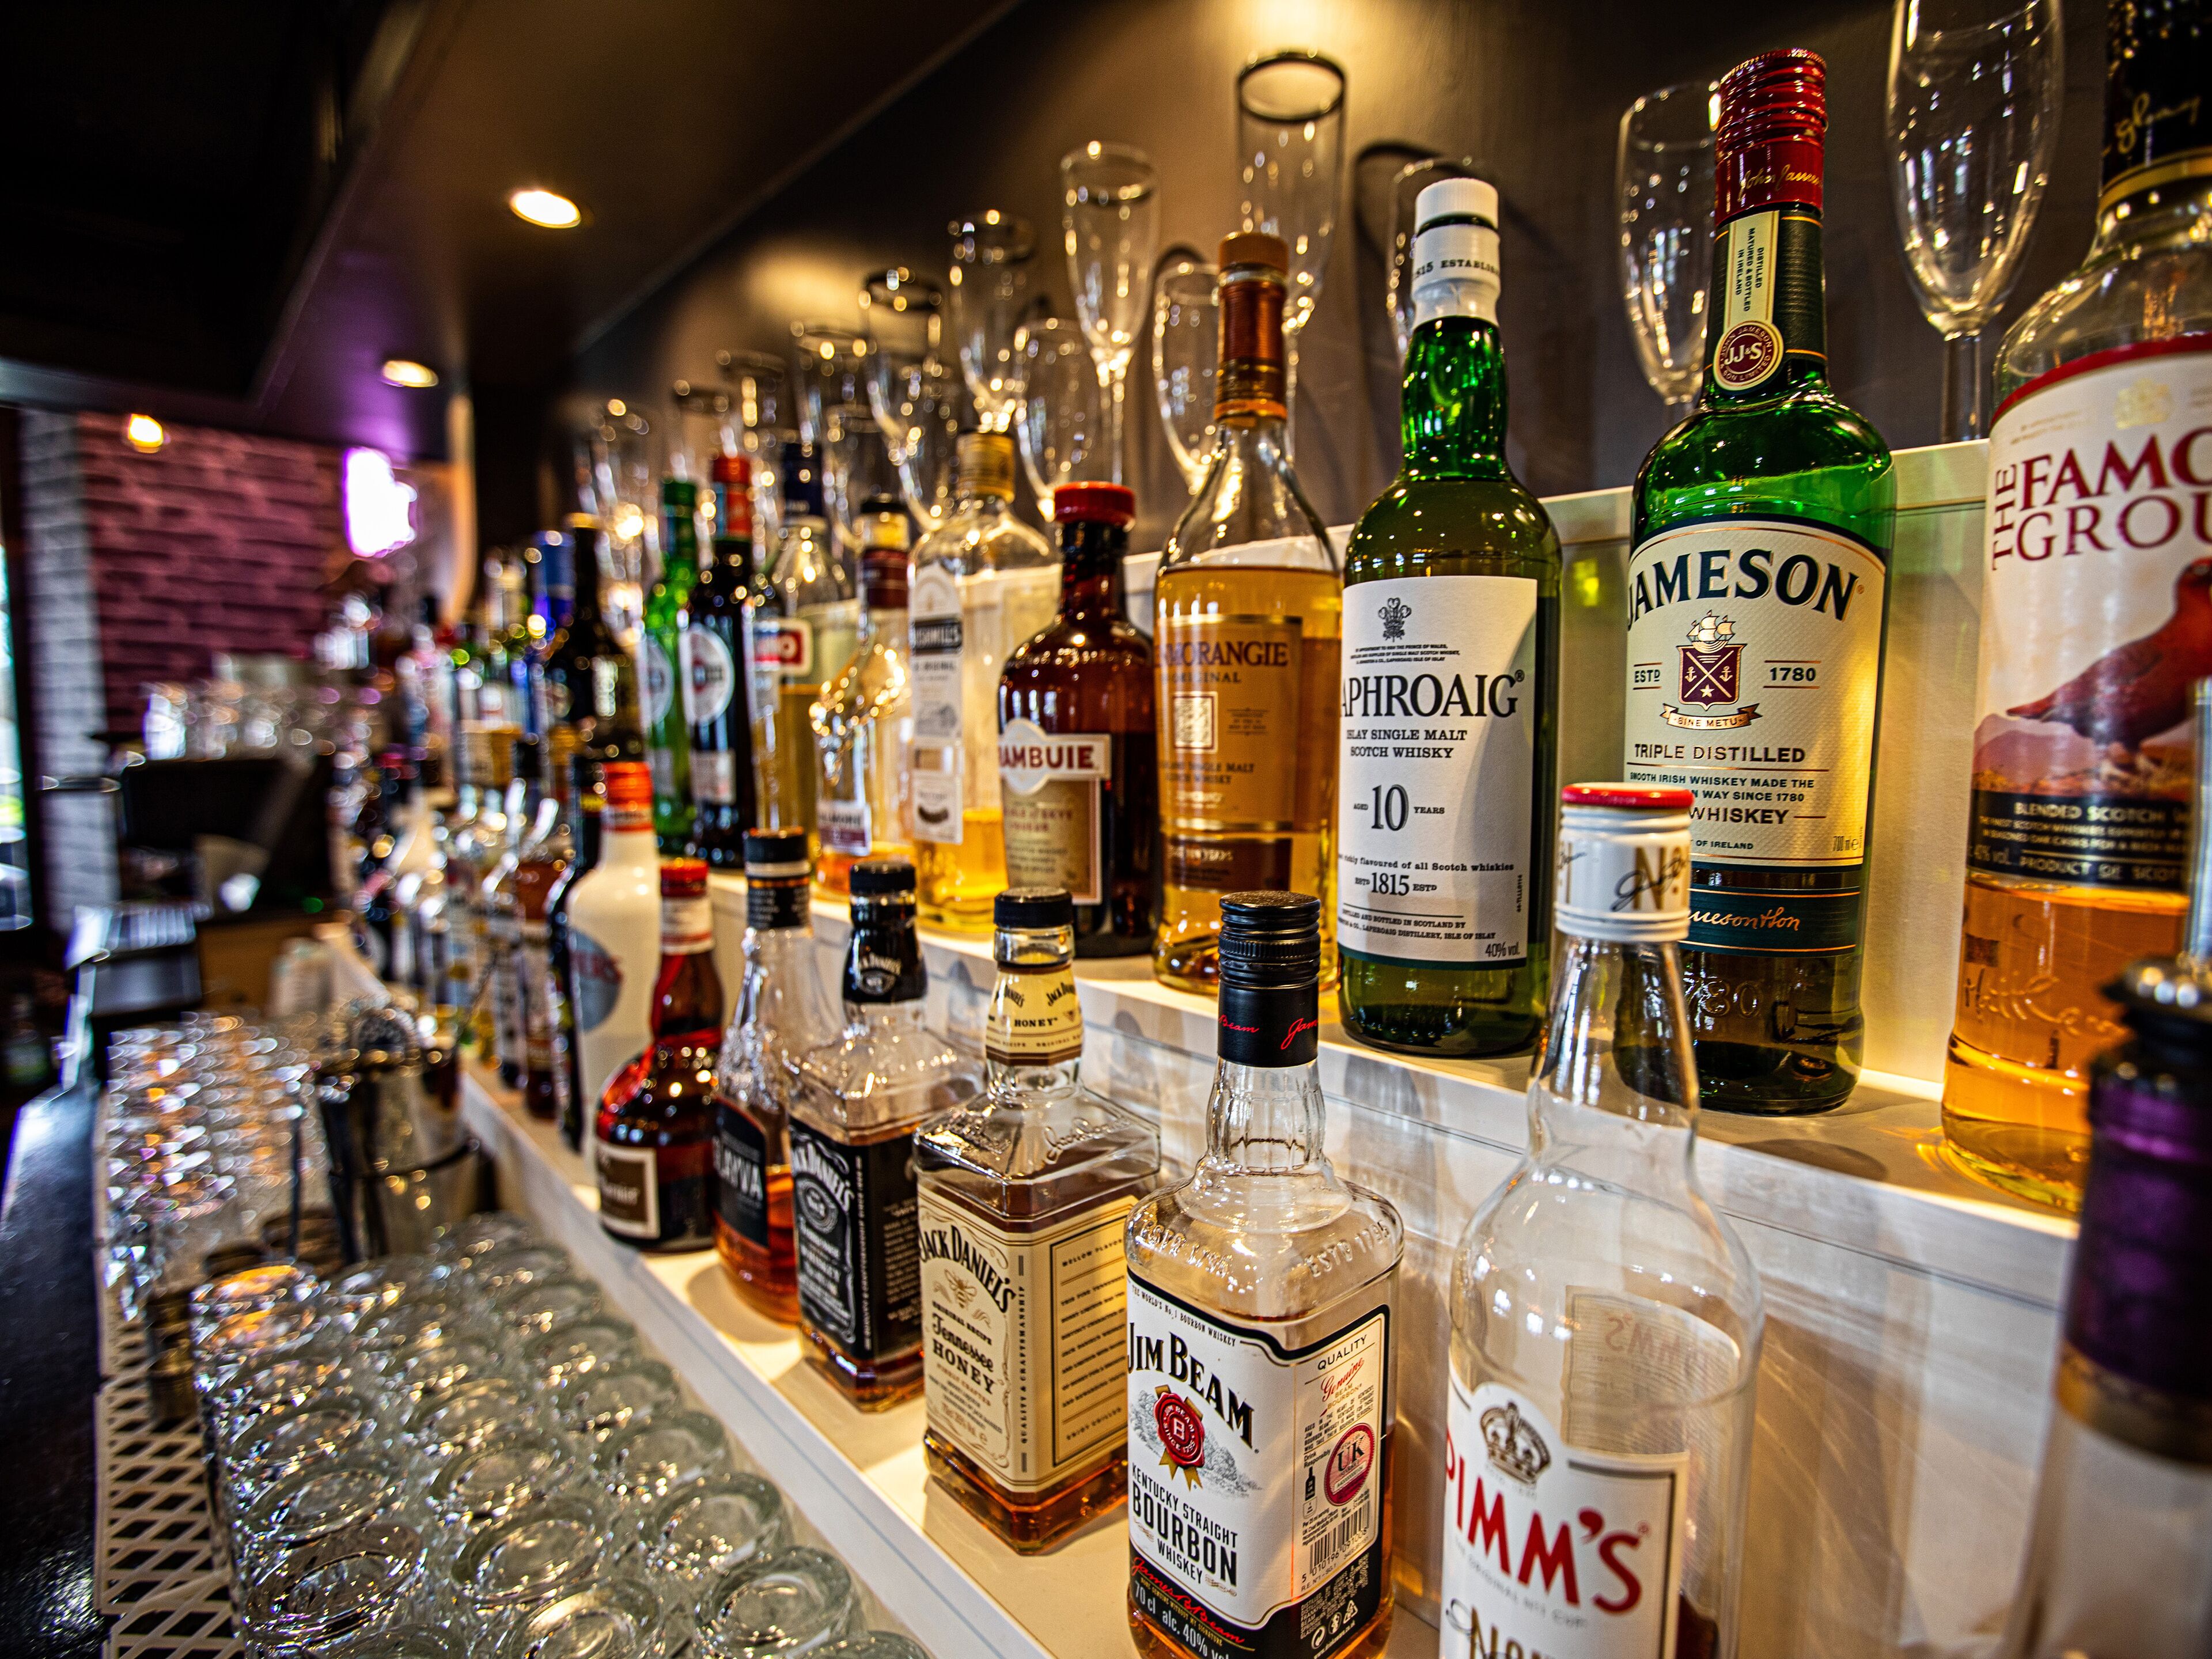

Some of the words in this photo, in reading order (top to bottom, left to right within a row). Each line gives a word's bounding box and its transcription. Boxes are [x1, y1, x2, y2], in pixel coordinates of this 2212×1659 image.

[1737, 249, 1745, 259] IN
[1746, 228, 1756, 267] MATURED
[1735, 260, 1744, 296] IRELAND
[1755, 247, 1764, 289] DISTILLED
[1743, 274, 1753, 312] BOTTLED
[1992, 464, 2016, 571] THE
[1627, 548, 1859, 632] JAMESON
[1769, 667, 1816, 682] 1780
[1346, 729, 1368, 740] ISLAY
[1371, 729, 1419, 740] SINGLE
[1423, 729, 1468, 741] MALT
[1705, 715, 1738, 728] METU
[1350, 747, 1389, 757] SCOTCH
[1393, 747, 1455, 759] WHISKY
[1635, 744, 1685, 759] TRIPLE
[1693, 746, 1805, 763] DISTILLED
[1658, 774, 1686, 784] IRISH
[1690, 776, 1748, 786] WHISKEY
[1750, 778, 1787, 788] MADE
[1791, 779, 1815, 789] THE
[1371, 784, 1410, 832] 10
[1413, 806, 1445, 815] YEARS
[1702, 790, 1730, 800] WAY
[1732, 791, 1773, 801] SINCE
[1776, 792, 1805, 802] 1780
[1688, 806, 1789, 825] WHISKEY
[1710, 840, 1754, 850] IRELAND
[1359, 857, 1398, 869] flavoured
[1402, 861, 1412, 870] of
[1415, 862, 1428, 870] all
[1431, 862, 1468, 872] Scotch
[1471, 863, 1514, 872] whiskies
[2020, 855, 2093, 876] PRODUCT
[1371, 872, 1410, 896] 1815
[1412, 884, 1437, 892] ESTD
[1361, 911, 1373, 921] AND
[1373, 915, 1402, 925] BOTTLED
[1413, 920, 1453, 929] SCOTLAND
[1455, 921, 1466, 929] BY
[1362, 925, 1396, 935] LAPHROAIG
[1398, 929, 1442, 940] DISTILLERY,
[1475, 932, 1496, 940] ISLAY
[1485, 940, 1507, 958] 40%
[1014, 1018, 1054, 1028] HONEY
[1218, 1014, 1260, 1033] Beam
[921, 1229, 949, 1264] JACK
[950, 1225, 1017, 1314] DANIEL'S
[1062, 1251, 1092, 1267] MELLOW
[1141, 1290, 1163, 1310] WORLD'S
[1180, 1313, 1206, 1333] BOURBON
[1207, 1327, 1236, 1347] WHISKEY
[932, 1312, 994, 1373] Tennessee
[1018, 1285, 1027, 1381] CRAFTSMANSHIP
[932, 1338, 995, 1395] HONEY
[1317, 1334, 1368, 1371] QUALITY
[1127, 1322, 1165, 1374] JIM
[1168, 1331, 1255, 1450] BEAM
[1320, 1357, 1365, 1403] Genuine
[1334, 1383, 1353, 1399] BEAM
[1327, 1386, 1359, 1410] BOURBON
[1020, 1395, 1028, 1444] QUALITY
[1175, 1405, 1195, 1433] BEAM
[1163, 1423, 1181, 1451] SINCE
[1304, 1451, 1317, 1462] Drink
[1304, 1449, 1331, 1469] Responsibly
[1337, 1434, 1365, 1472] UK
[1131, 1462, 1179, 1513] KENTUCKY
[1182, 1502, 1238, 1550] STRAIGHT
[1132, 1480, 1238, 1588] BOURBON
[1157, 1537, 1203, 1585] WHISKEY
[1301, 1572, 1307, 1583] 5
[1311, 1551, 1340, 1576] 010196
[1131, 1556, 1175, 1597] James
[1135, 1580, 1146, 1605] 70
[1147, 1596, 1156, 1615] cl
[1161, 1609, 1181, 1635] alc.
[1183, 1623, 1209, 1657] 40%
